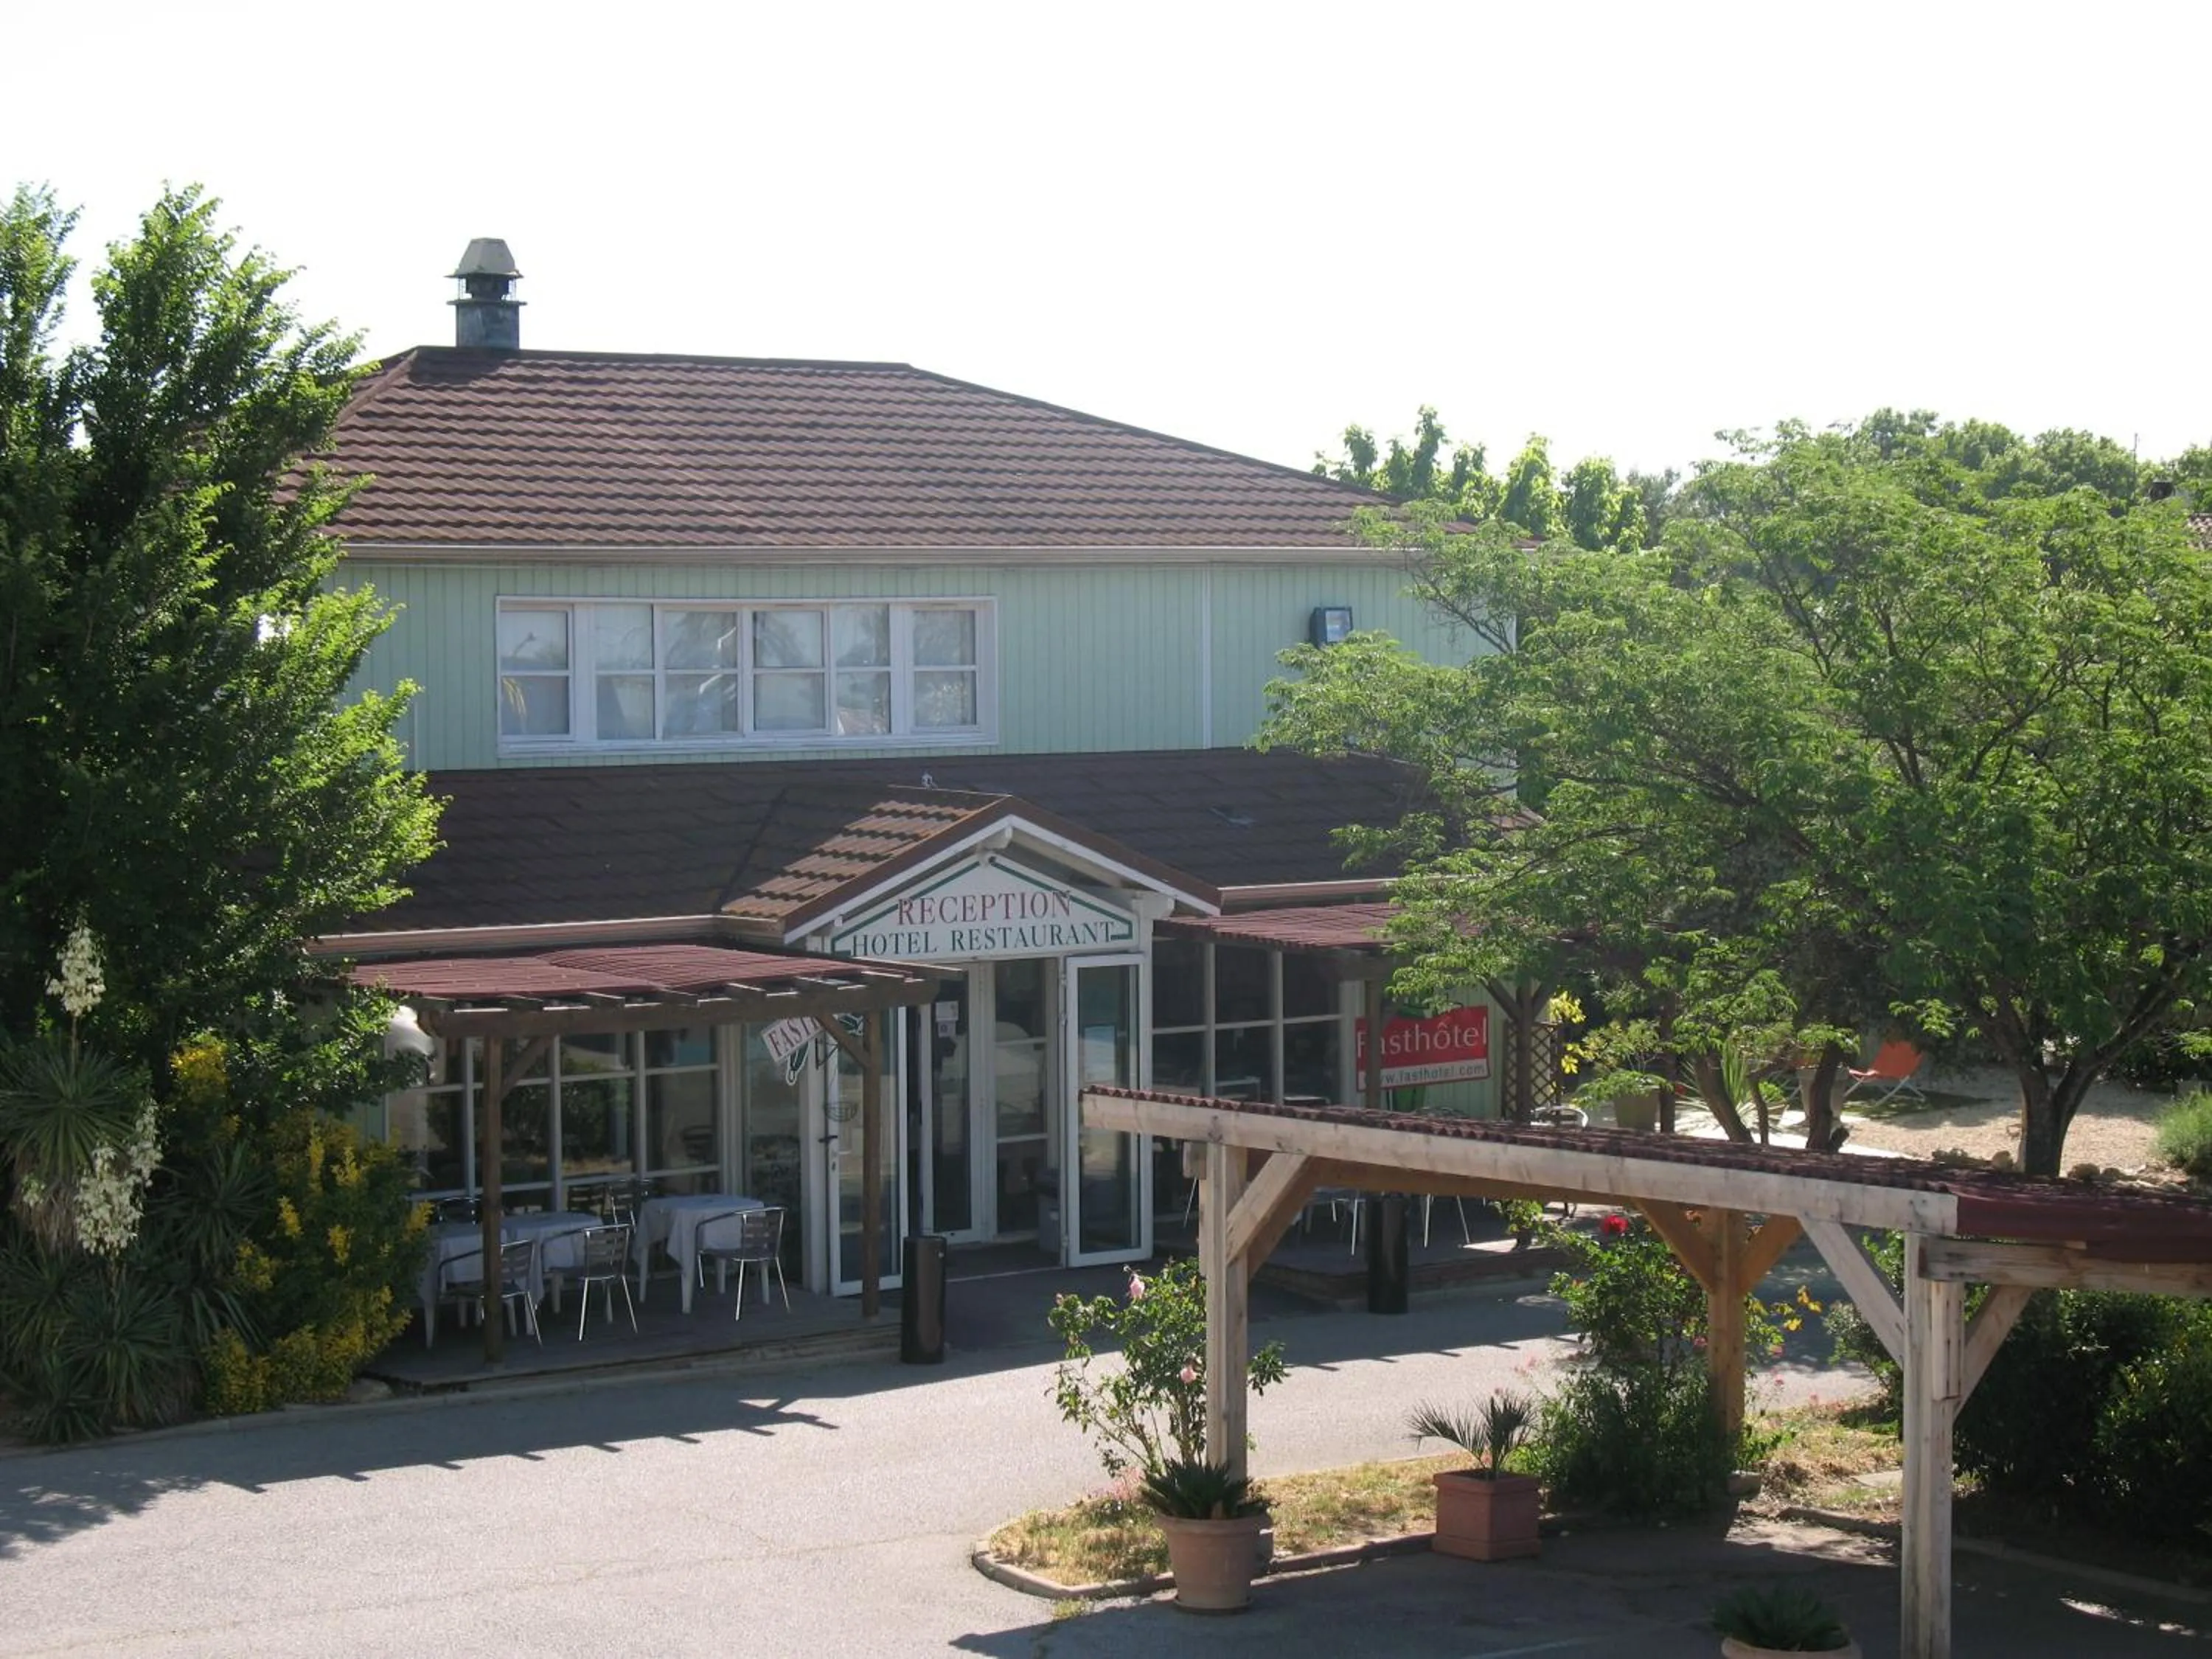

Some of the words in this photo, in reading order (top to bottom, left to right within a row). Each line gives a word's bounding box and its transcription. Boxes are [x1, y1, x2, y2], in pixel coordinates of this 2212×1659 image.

[897, 890, 1071, 926] RECEPTION
[852, 931, 938, 957] HOTEL
[951, 921, 1115, 953] RESTAURANT
